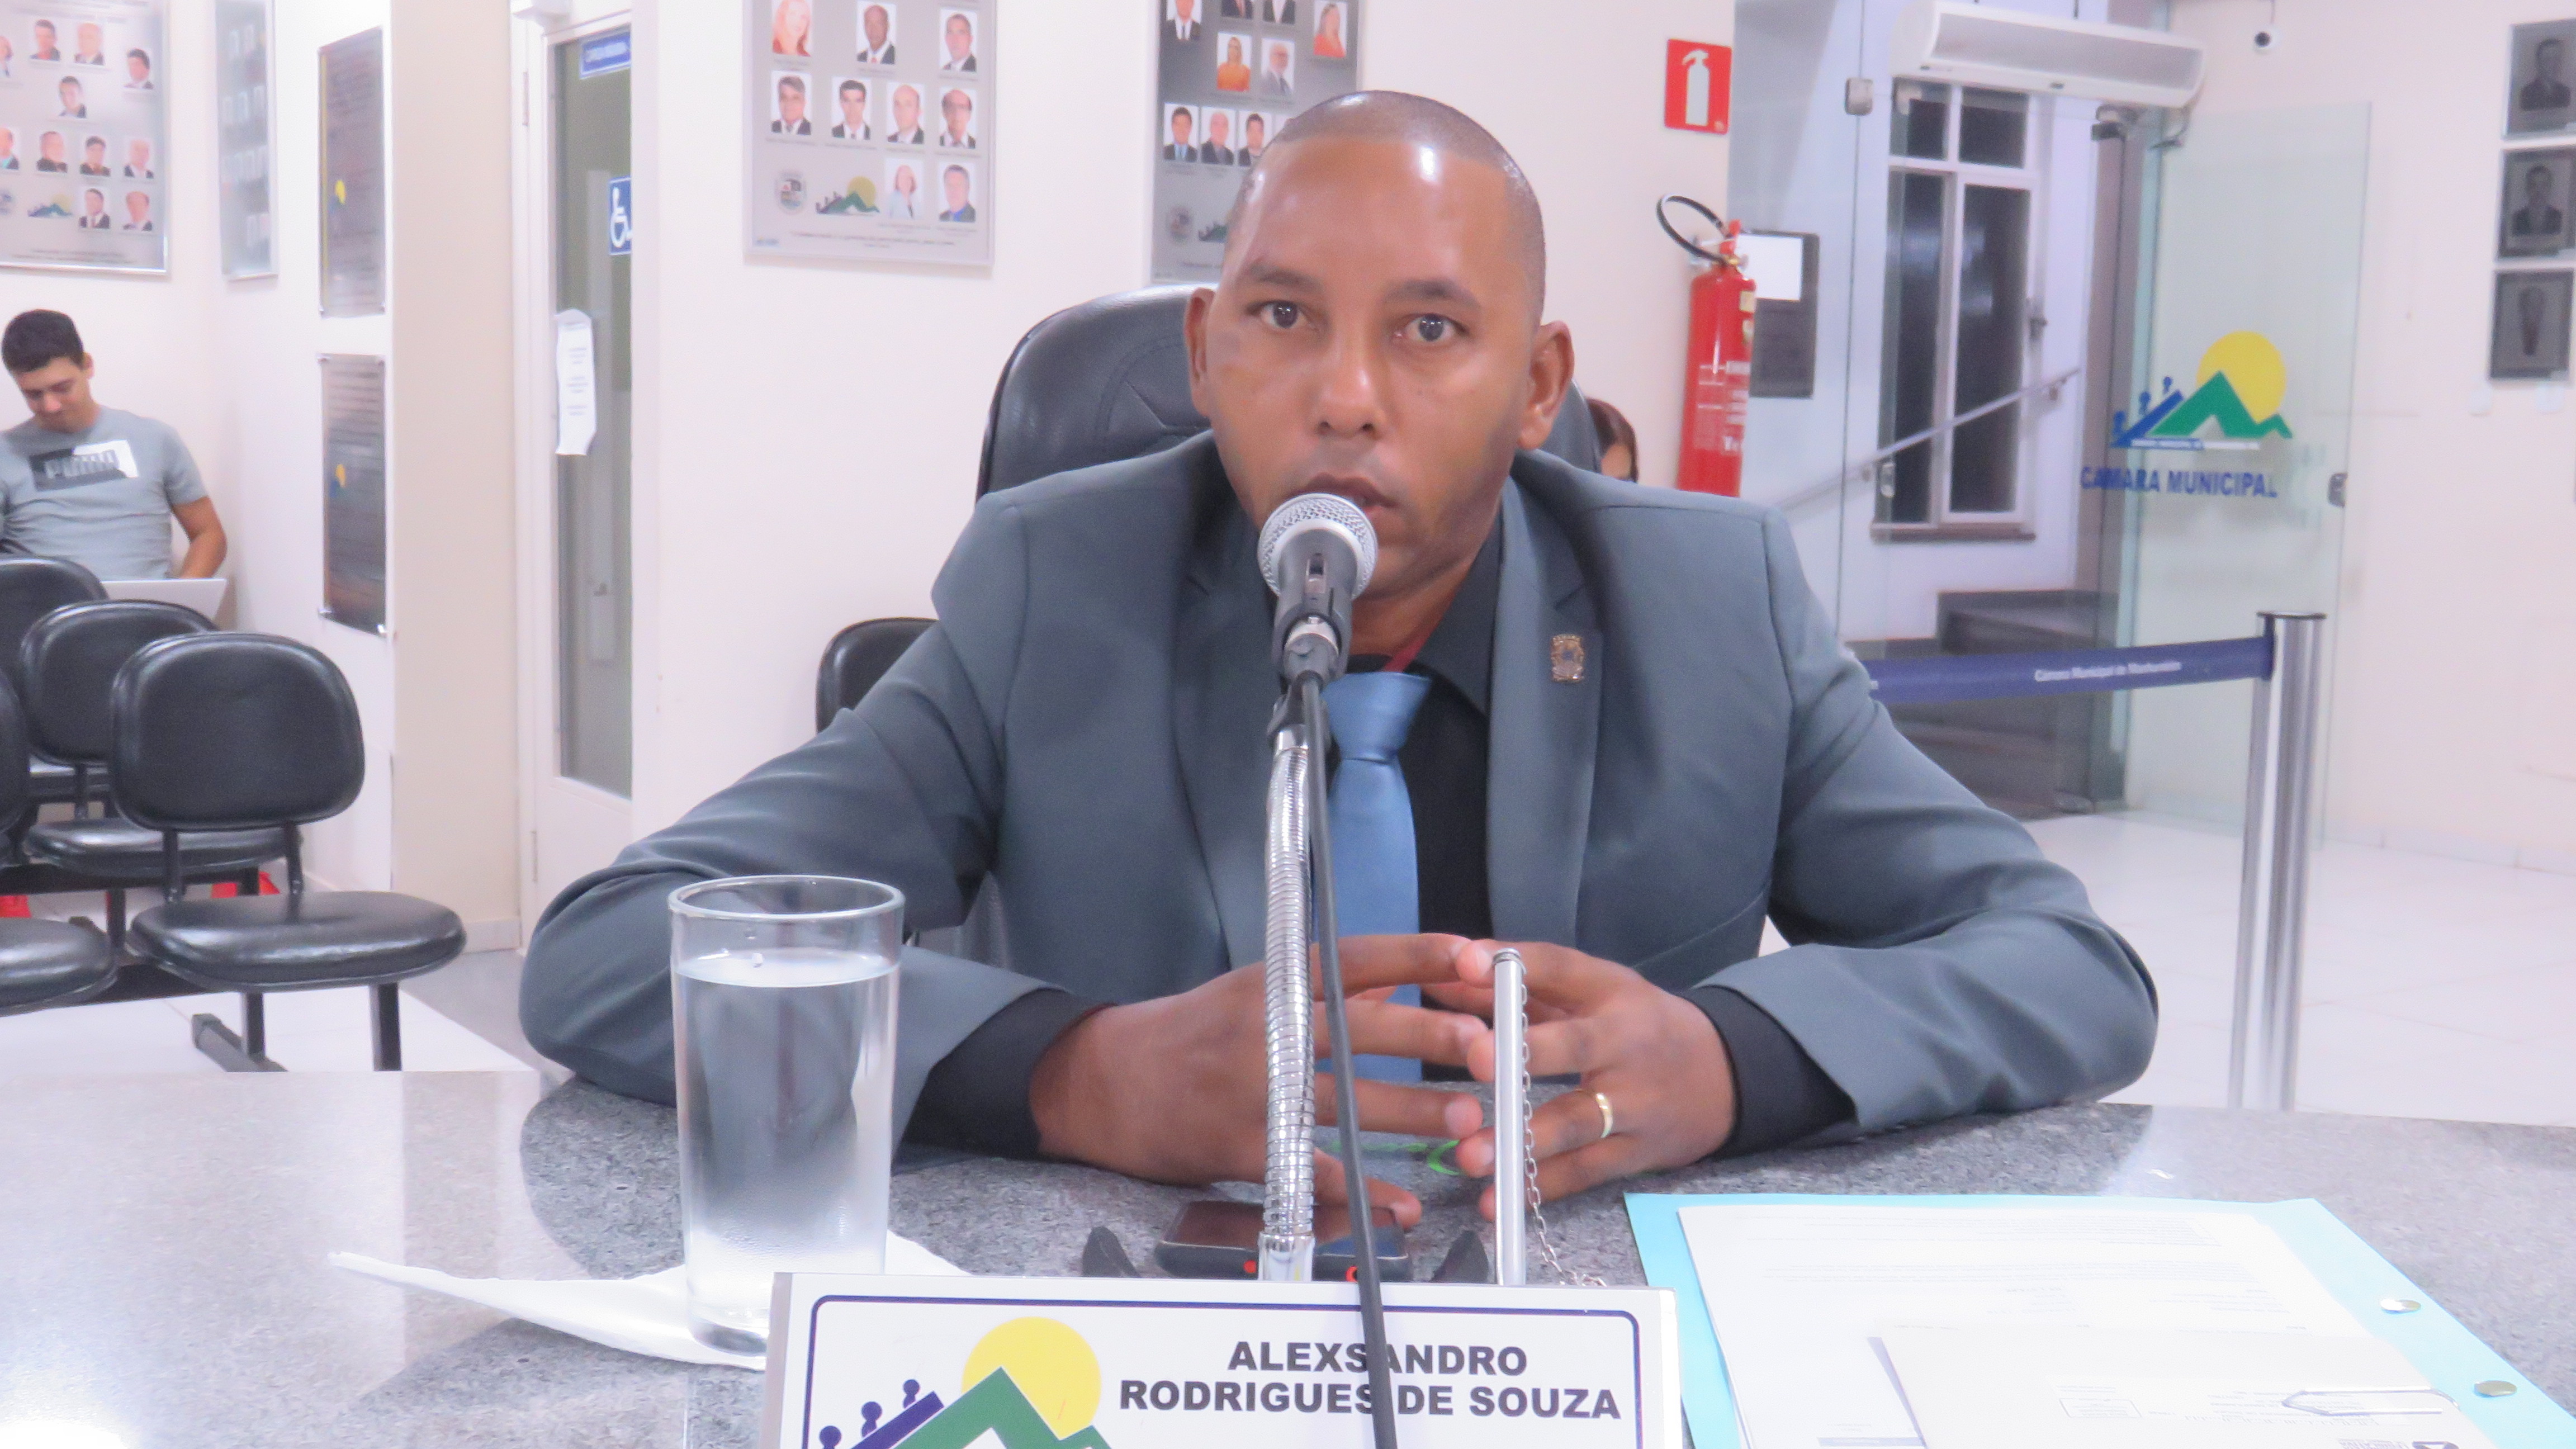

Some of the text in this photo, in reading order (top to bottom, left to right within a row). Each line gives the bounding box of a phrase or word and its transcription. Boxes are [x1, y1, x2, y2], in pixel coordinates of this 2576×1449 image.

[2166, 470, 2278, 498] MUNICIPAL
[1119, 1380, 1621, 1419] RODRIGUES DE SOUZA
